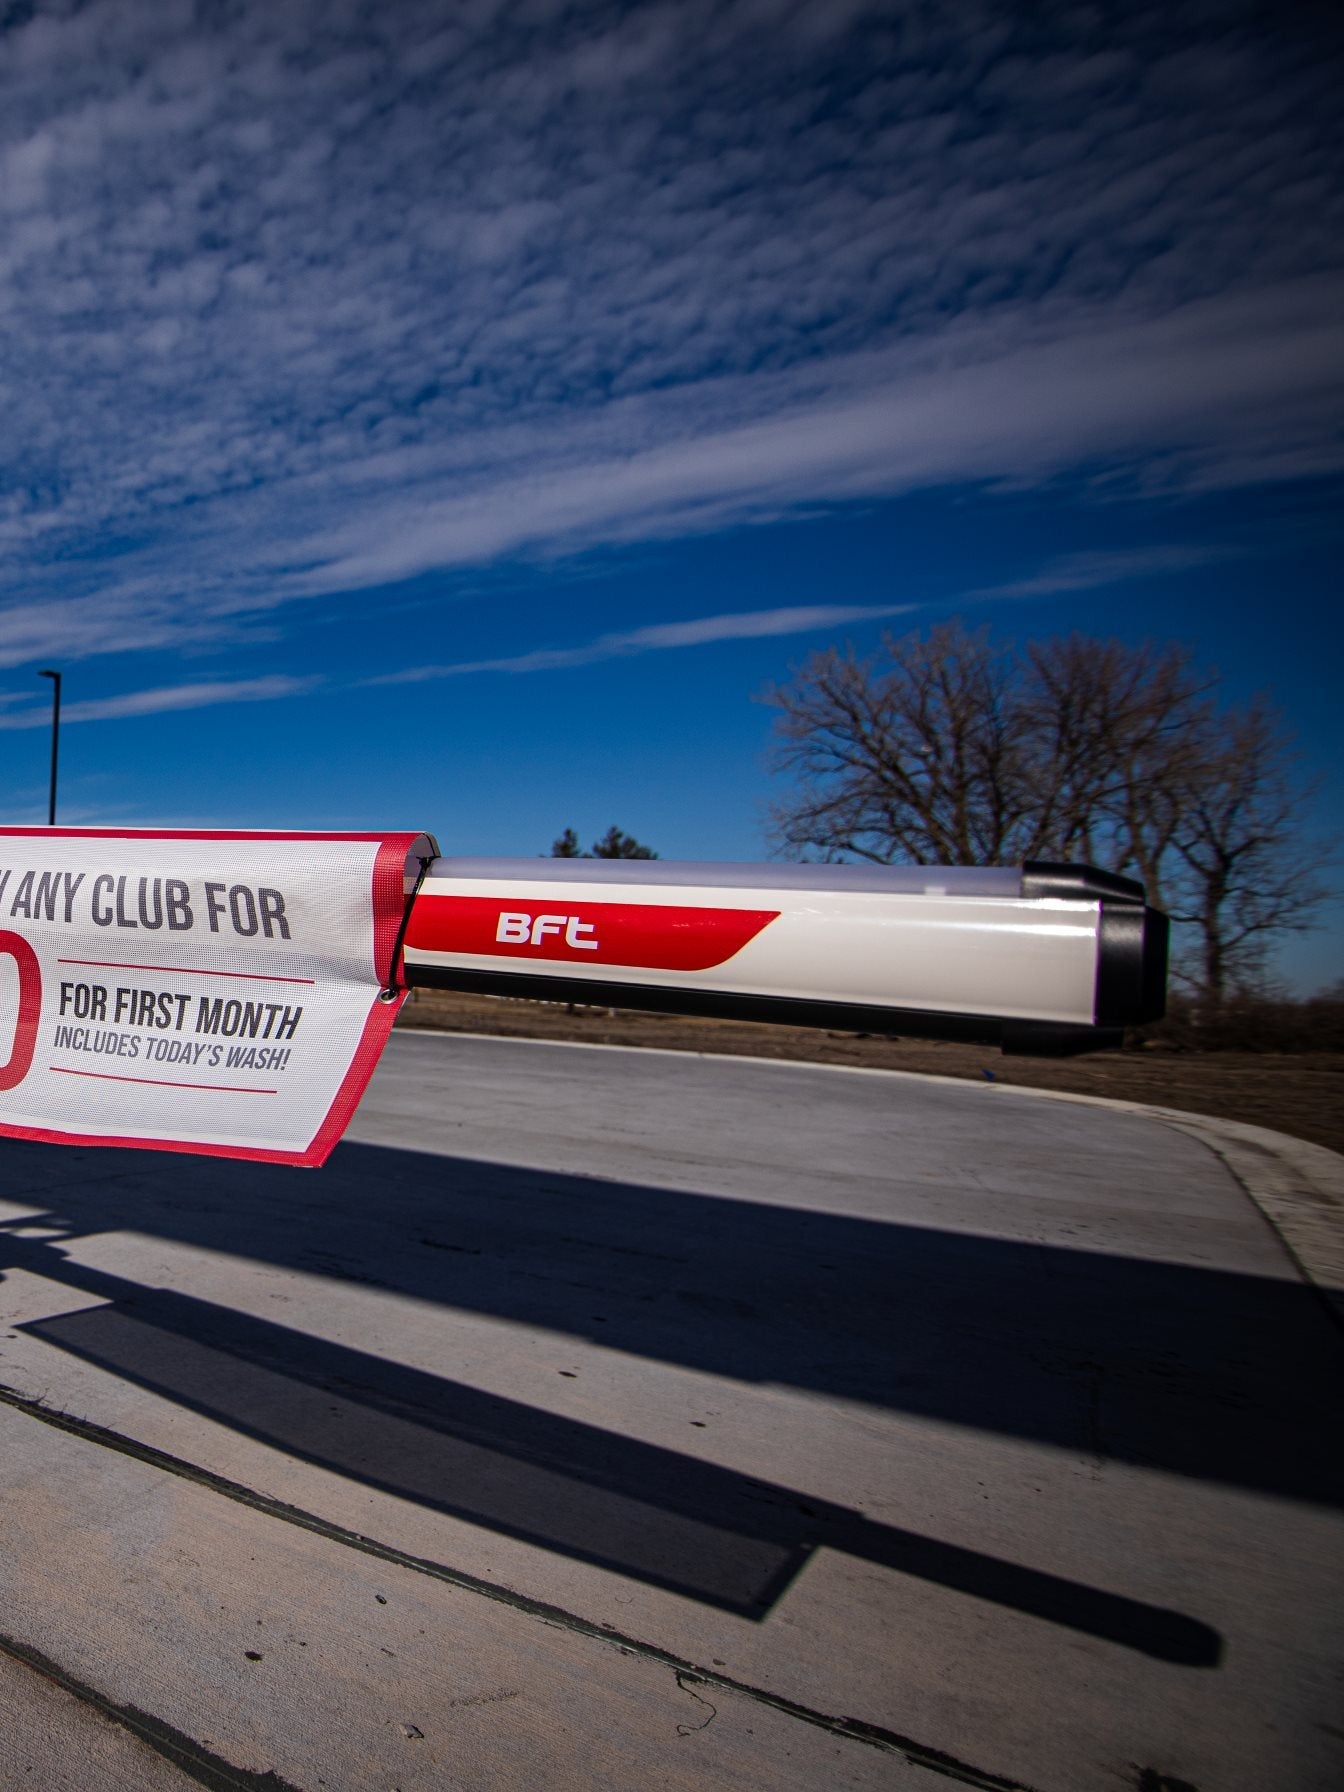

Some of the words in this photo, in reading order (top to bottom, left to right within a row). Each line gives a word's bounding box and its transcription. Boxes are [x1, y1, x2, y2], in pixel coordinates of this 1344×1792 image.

[10, 871, 86, 922] ANY
[91, 873, 194, 931] CLUB
[204, 881, 292, 940] FOR
[59, 982, 107, 1022] FOR
[113, 987, 191, 1031] FIRST
[195, 996, 304, 1040] MONTH
[53, 1025, 142, 1058] INCLUDES
[145, 1037, 224, 1067] TODAY'S
[225, 1046, 292, 1071] WASH!
